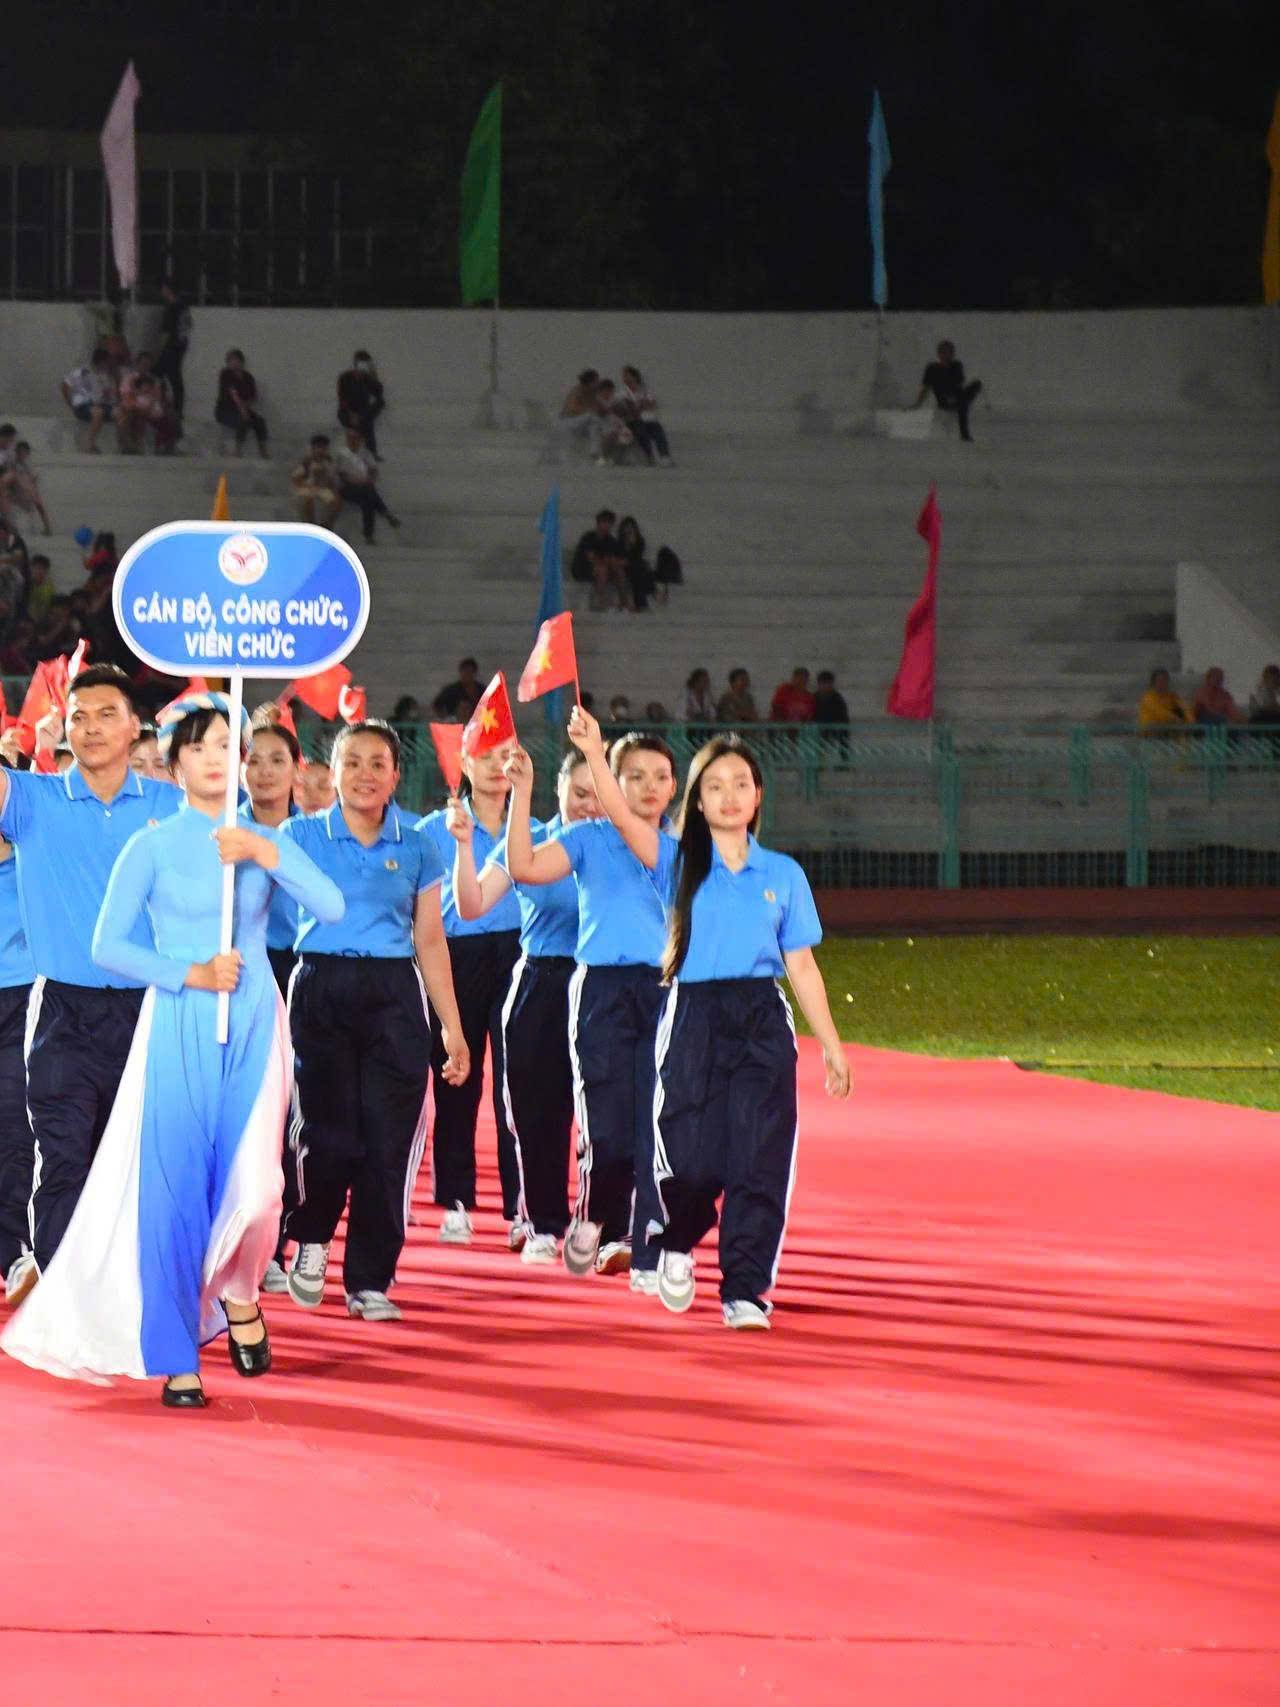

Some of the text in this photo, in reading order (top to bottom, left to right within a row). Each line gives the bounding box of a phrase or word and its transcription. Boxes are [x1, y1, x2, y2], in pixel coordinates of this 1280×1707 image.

[133, 592, 348, 630] CÁN BỘ, CÔNG CHỨC,
[184, 628, 296, 658] VIÊN CHỨC
